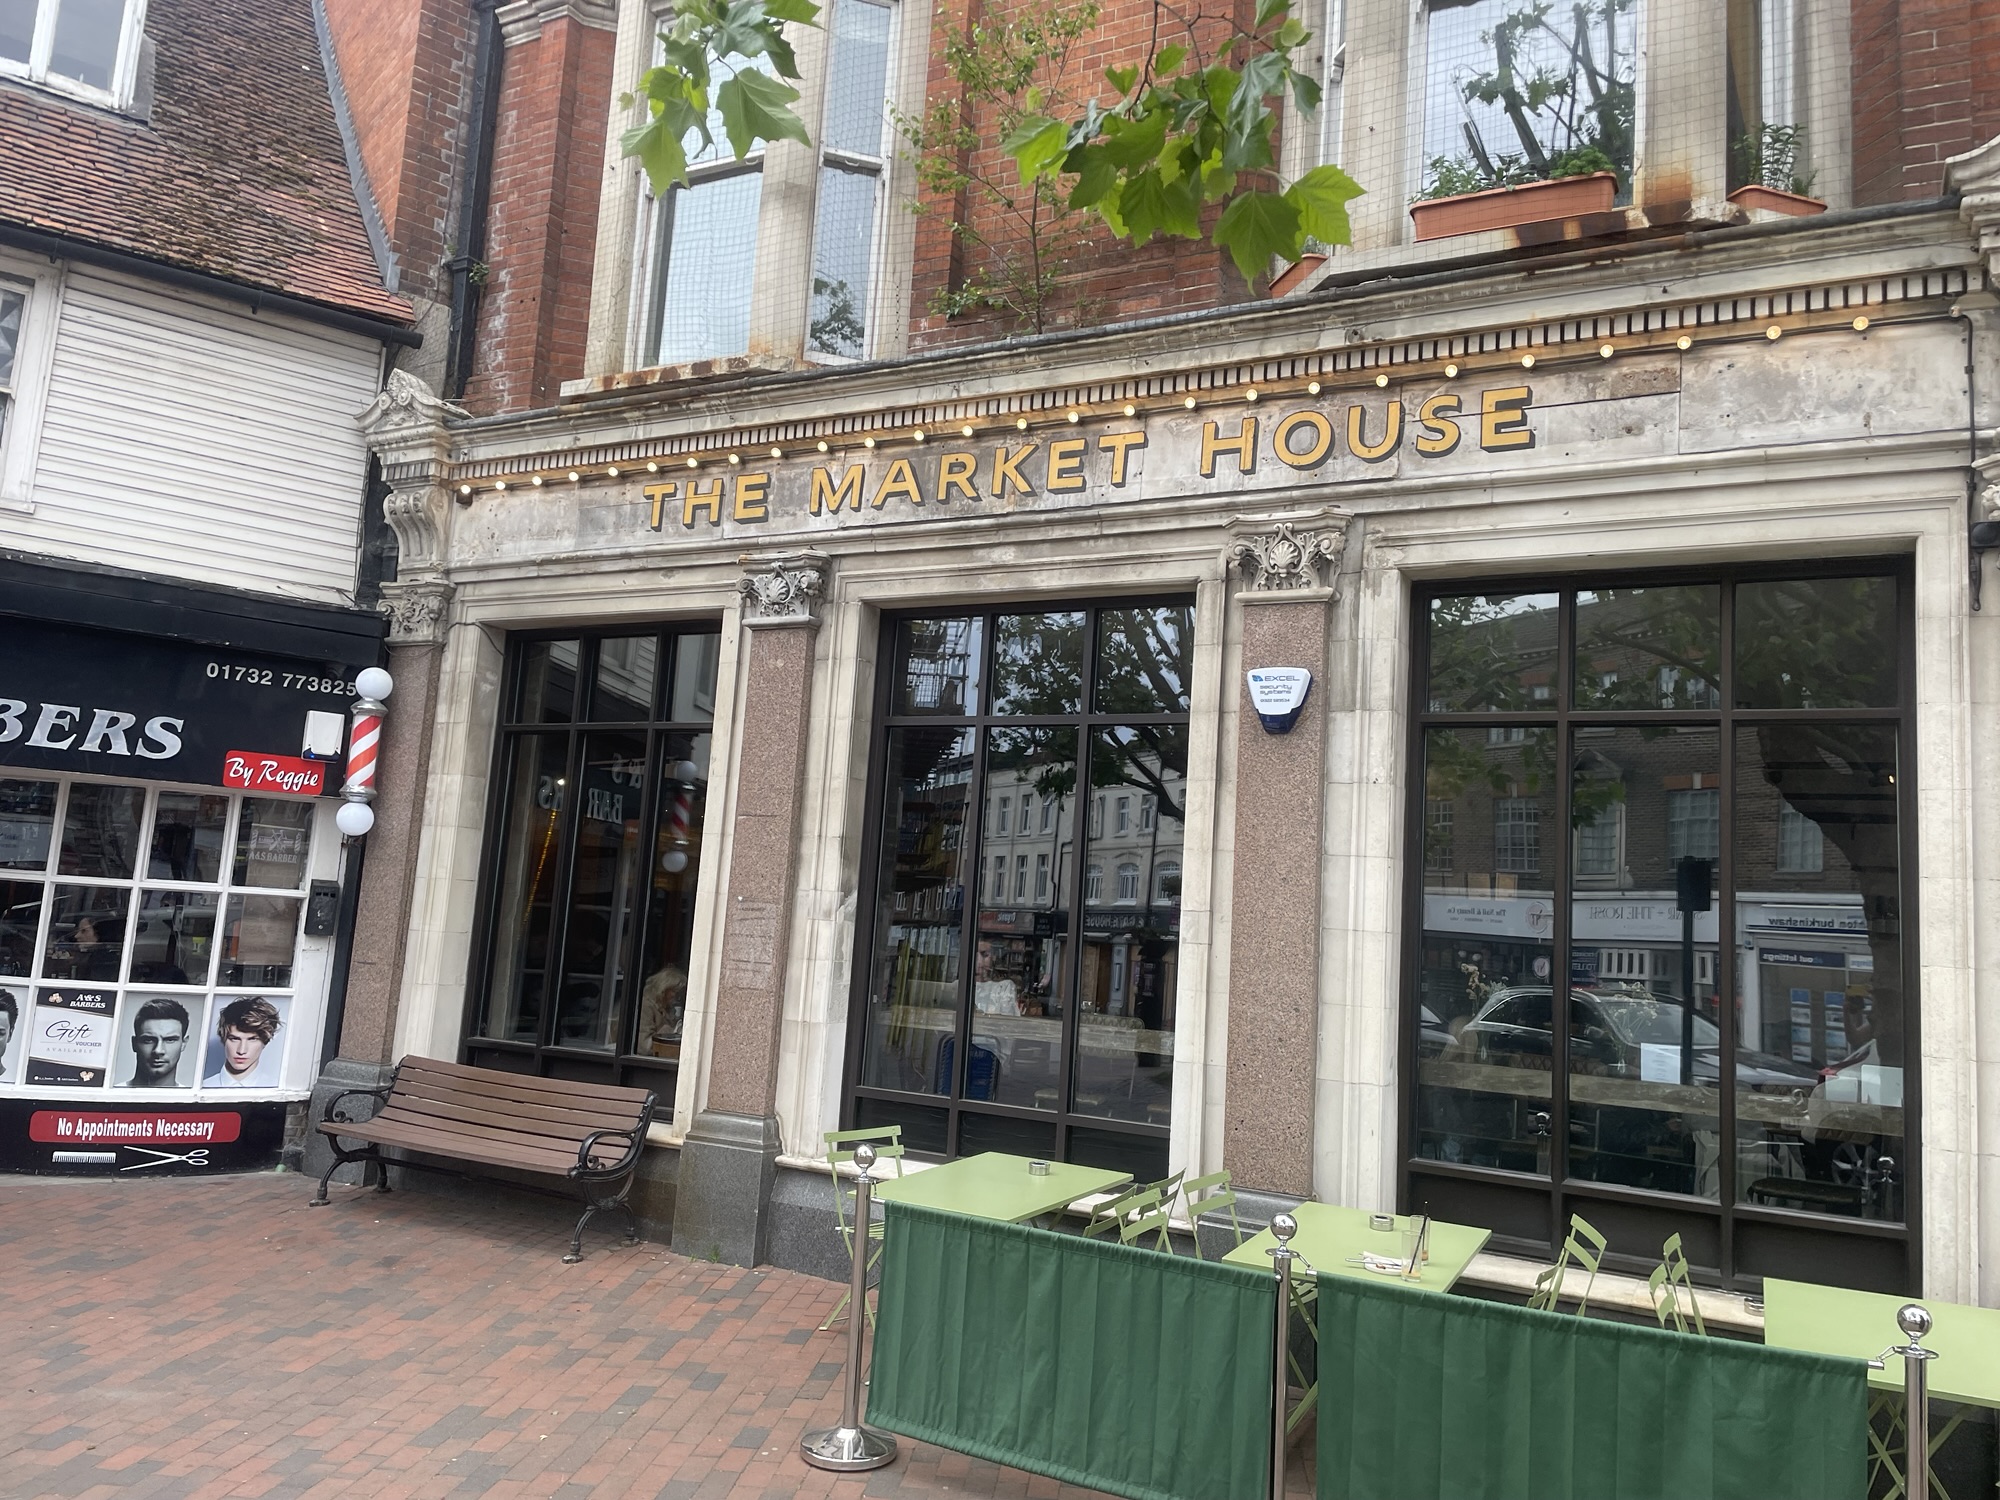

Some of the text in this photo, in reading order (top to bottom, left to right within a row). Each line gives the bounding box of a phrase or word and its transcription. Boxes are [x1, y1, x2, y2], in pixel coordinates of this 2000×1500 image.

[643, 385, 1537, 533] THE MARKET HOUSE
[206, 662, 357, 696] 01732 773825
[226, 757, 319, 792] By Reggie
[266, 852, 298, 864] BARBER
[69, 1000, 106, 1009] BARBERS
[76, 993, 102, 1002] A&S
[45, 1020, 94, 1043] Gift
[57, 1116, 215, 1142] No Appointments Necessary
